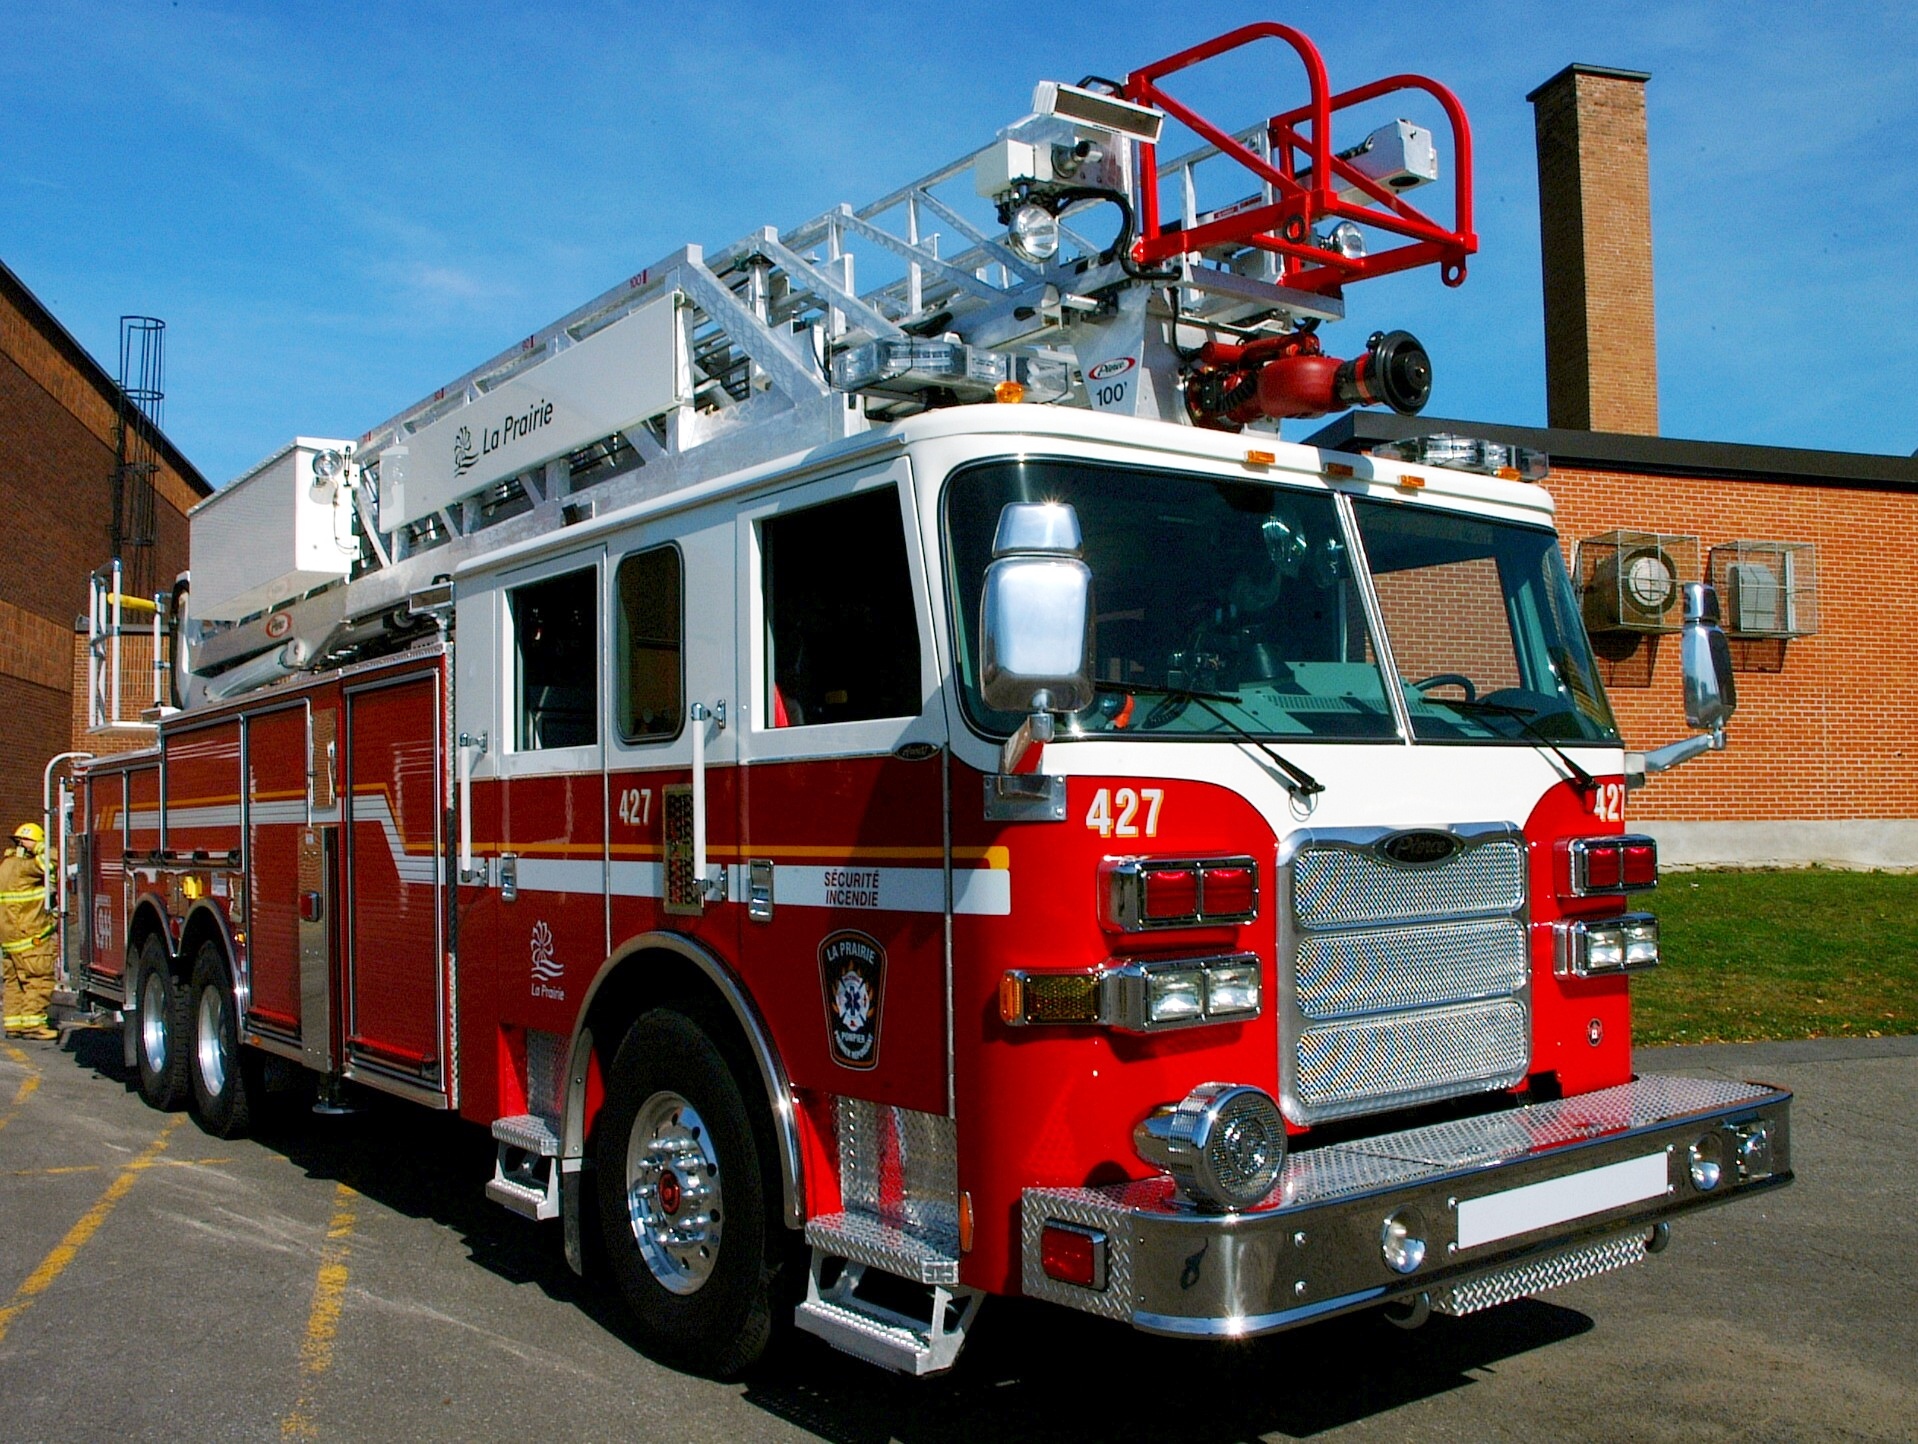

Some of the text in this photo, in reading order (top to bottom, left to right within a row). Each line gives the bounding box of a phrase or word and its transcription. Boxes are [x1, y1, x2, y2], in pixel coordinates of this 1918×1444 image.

[483, 398, 553, 455] La Prairie
[619, 788, 652, 826] 427
[1086, 787, 1164, 838] 427
[824, 868, 880, 889] SÉCURITÉ
[825, 890, 879, 907] INCENDIE
[826, 941, 876, 965] LA PRAIRIE
[531, 983, 565, 1001] La Prairie
